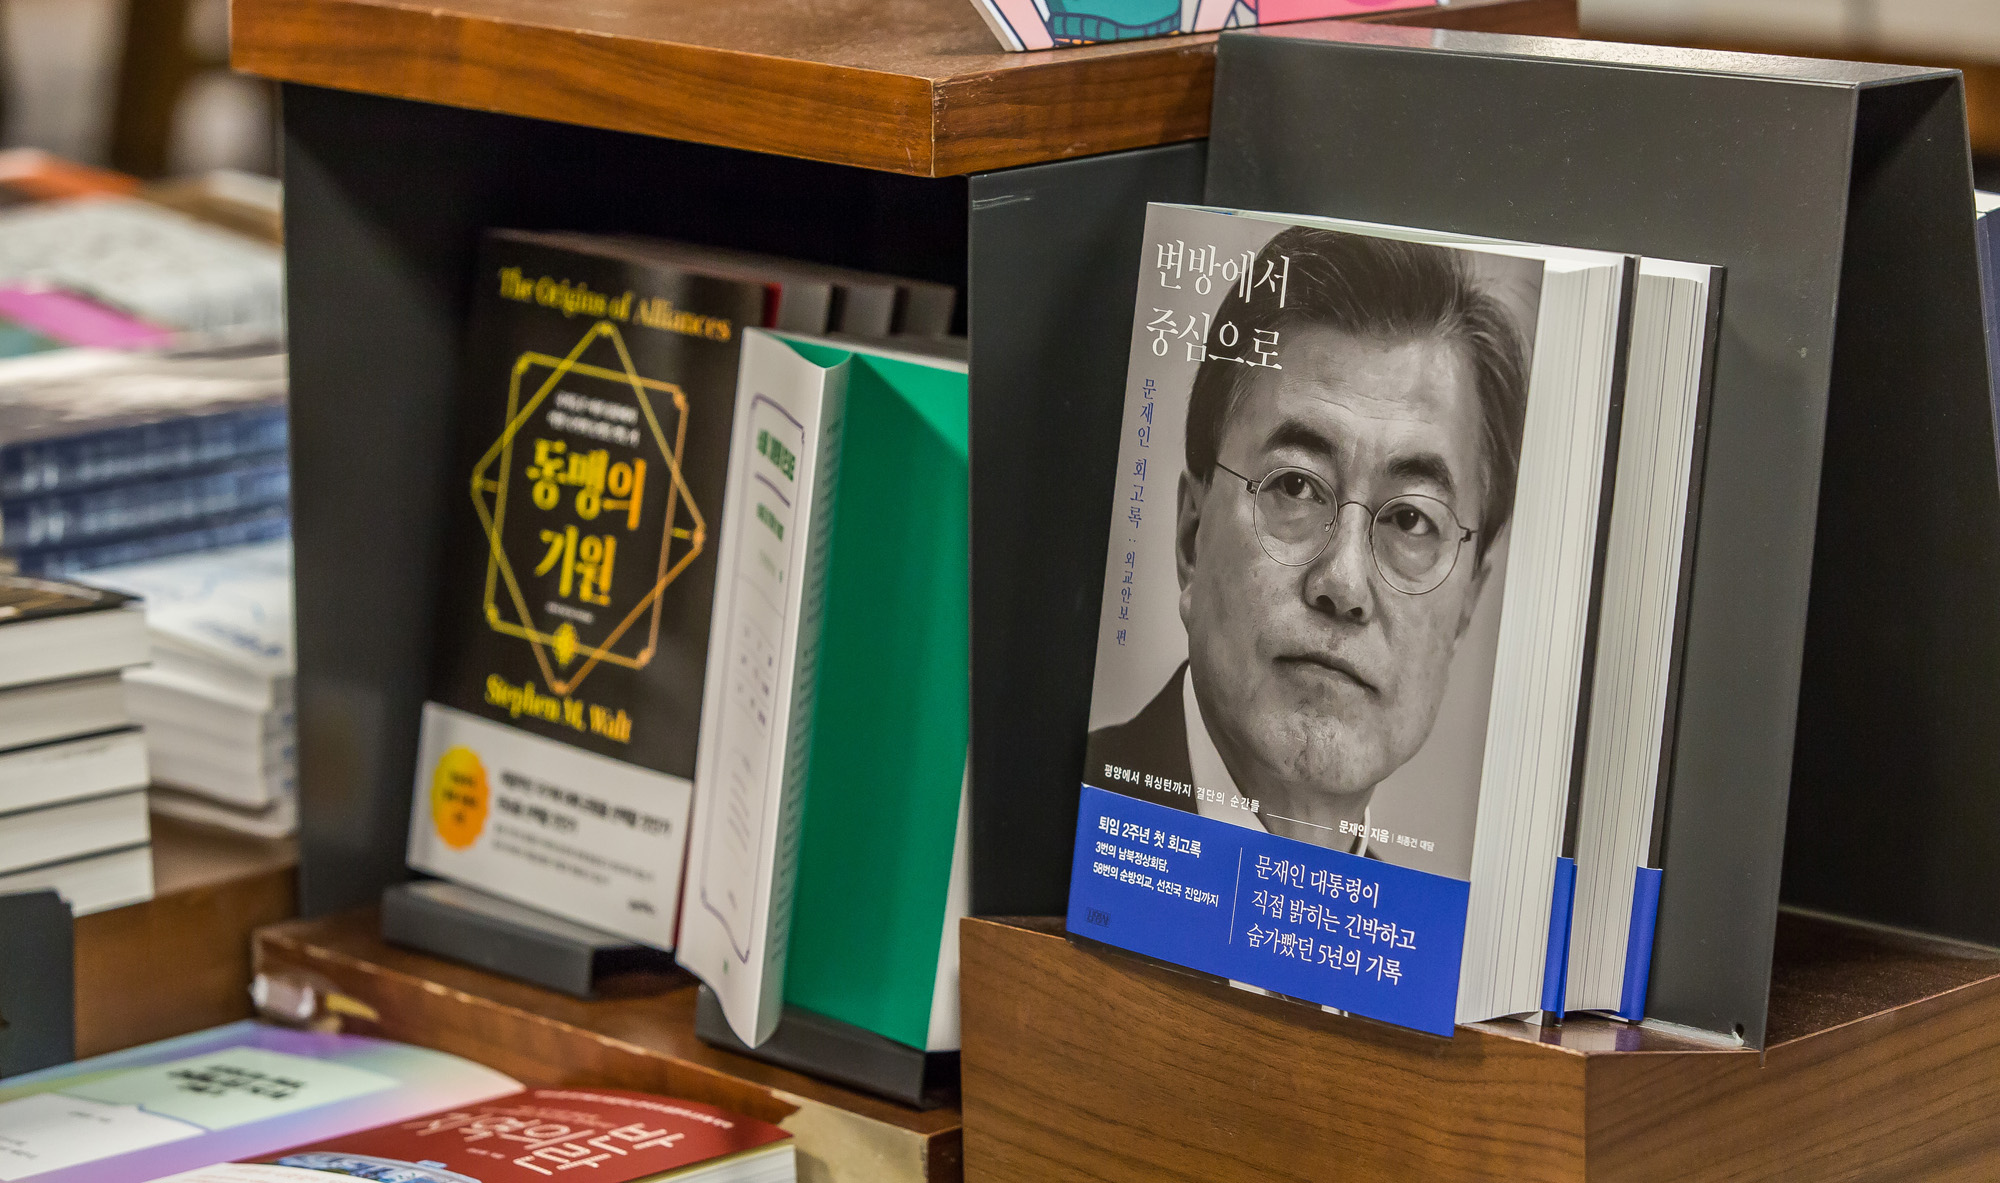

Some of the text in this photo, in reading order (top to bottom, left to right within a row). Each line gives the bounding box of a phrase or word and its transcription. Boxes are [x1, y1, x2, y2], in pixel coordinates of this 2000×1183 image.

[499, 267, 732, 342] The Origins of Alliances
[1156, 239, 1290, 308] 변방에서
[1146, 307, 1283, 370] 중심으로
[1137, 378, 1157, 449] 문재인
[526, 437, 647, 530] 동맹의
[1127, 458, 1147, 529] 회고록
[534, 525, 617, 606] 기원
[1118, 551, 1136, 620] 외교안보
[1116, 628, 1127, 646] 편
[485, 673, 561, 723] Stephen
[589, 703, 632, 744] Walt
[1098, 815, 1202, 859] 퇴임 2주년 첫 회고록
[1104, 763, 1140, 785] 평양에서
[1144, 774, 1192, 797] 워싱턴까지
[1196, 786, 1225, 805] 결단의
[1230, 794, 1260, 814] 순간들
[1338, 820, 1367, 838] 문재인
[1370, 827, 1389, 844] 지음
[1419, 840, 1435, 852] 대담
[1092, 861, 1219, 908] 58번의 순방외교, 선진국 진입까지
[1095, 841, 1169, 874] 3번의 남북정상회담,
[1254, 854, 1380, 909] 문재인 대통령이
[1246, 922, 1403, 986] 숨가빴던 5년의 기록
[1251, 889, 1417, 950] 직접 밝히는 긴박하고
